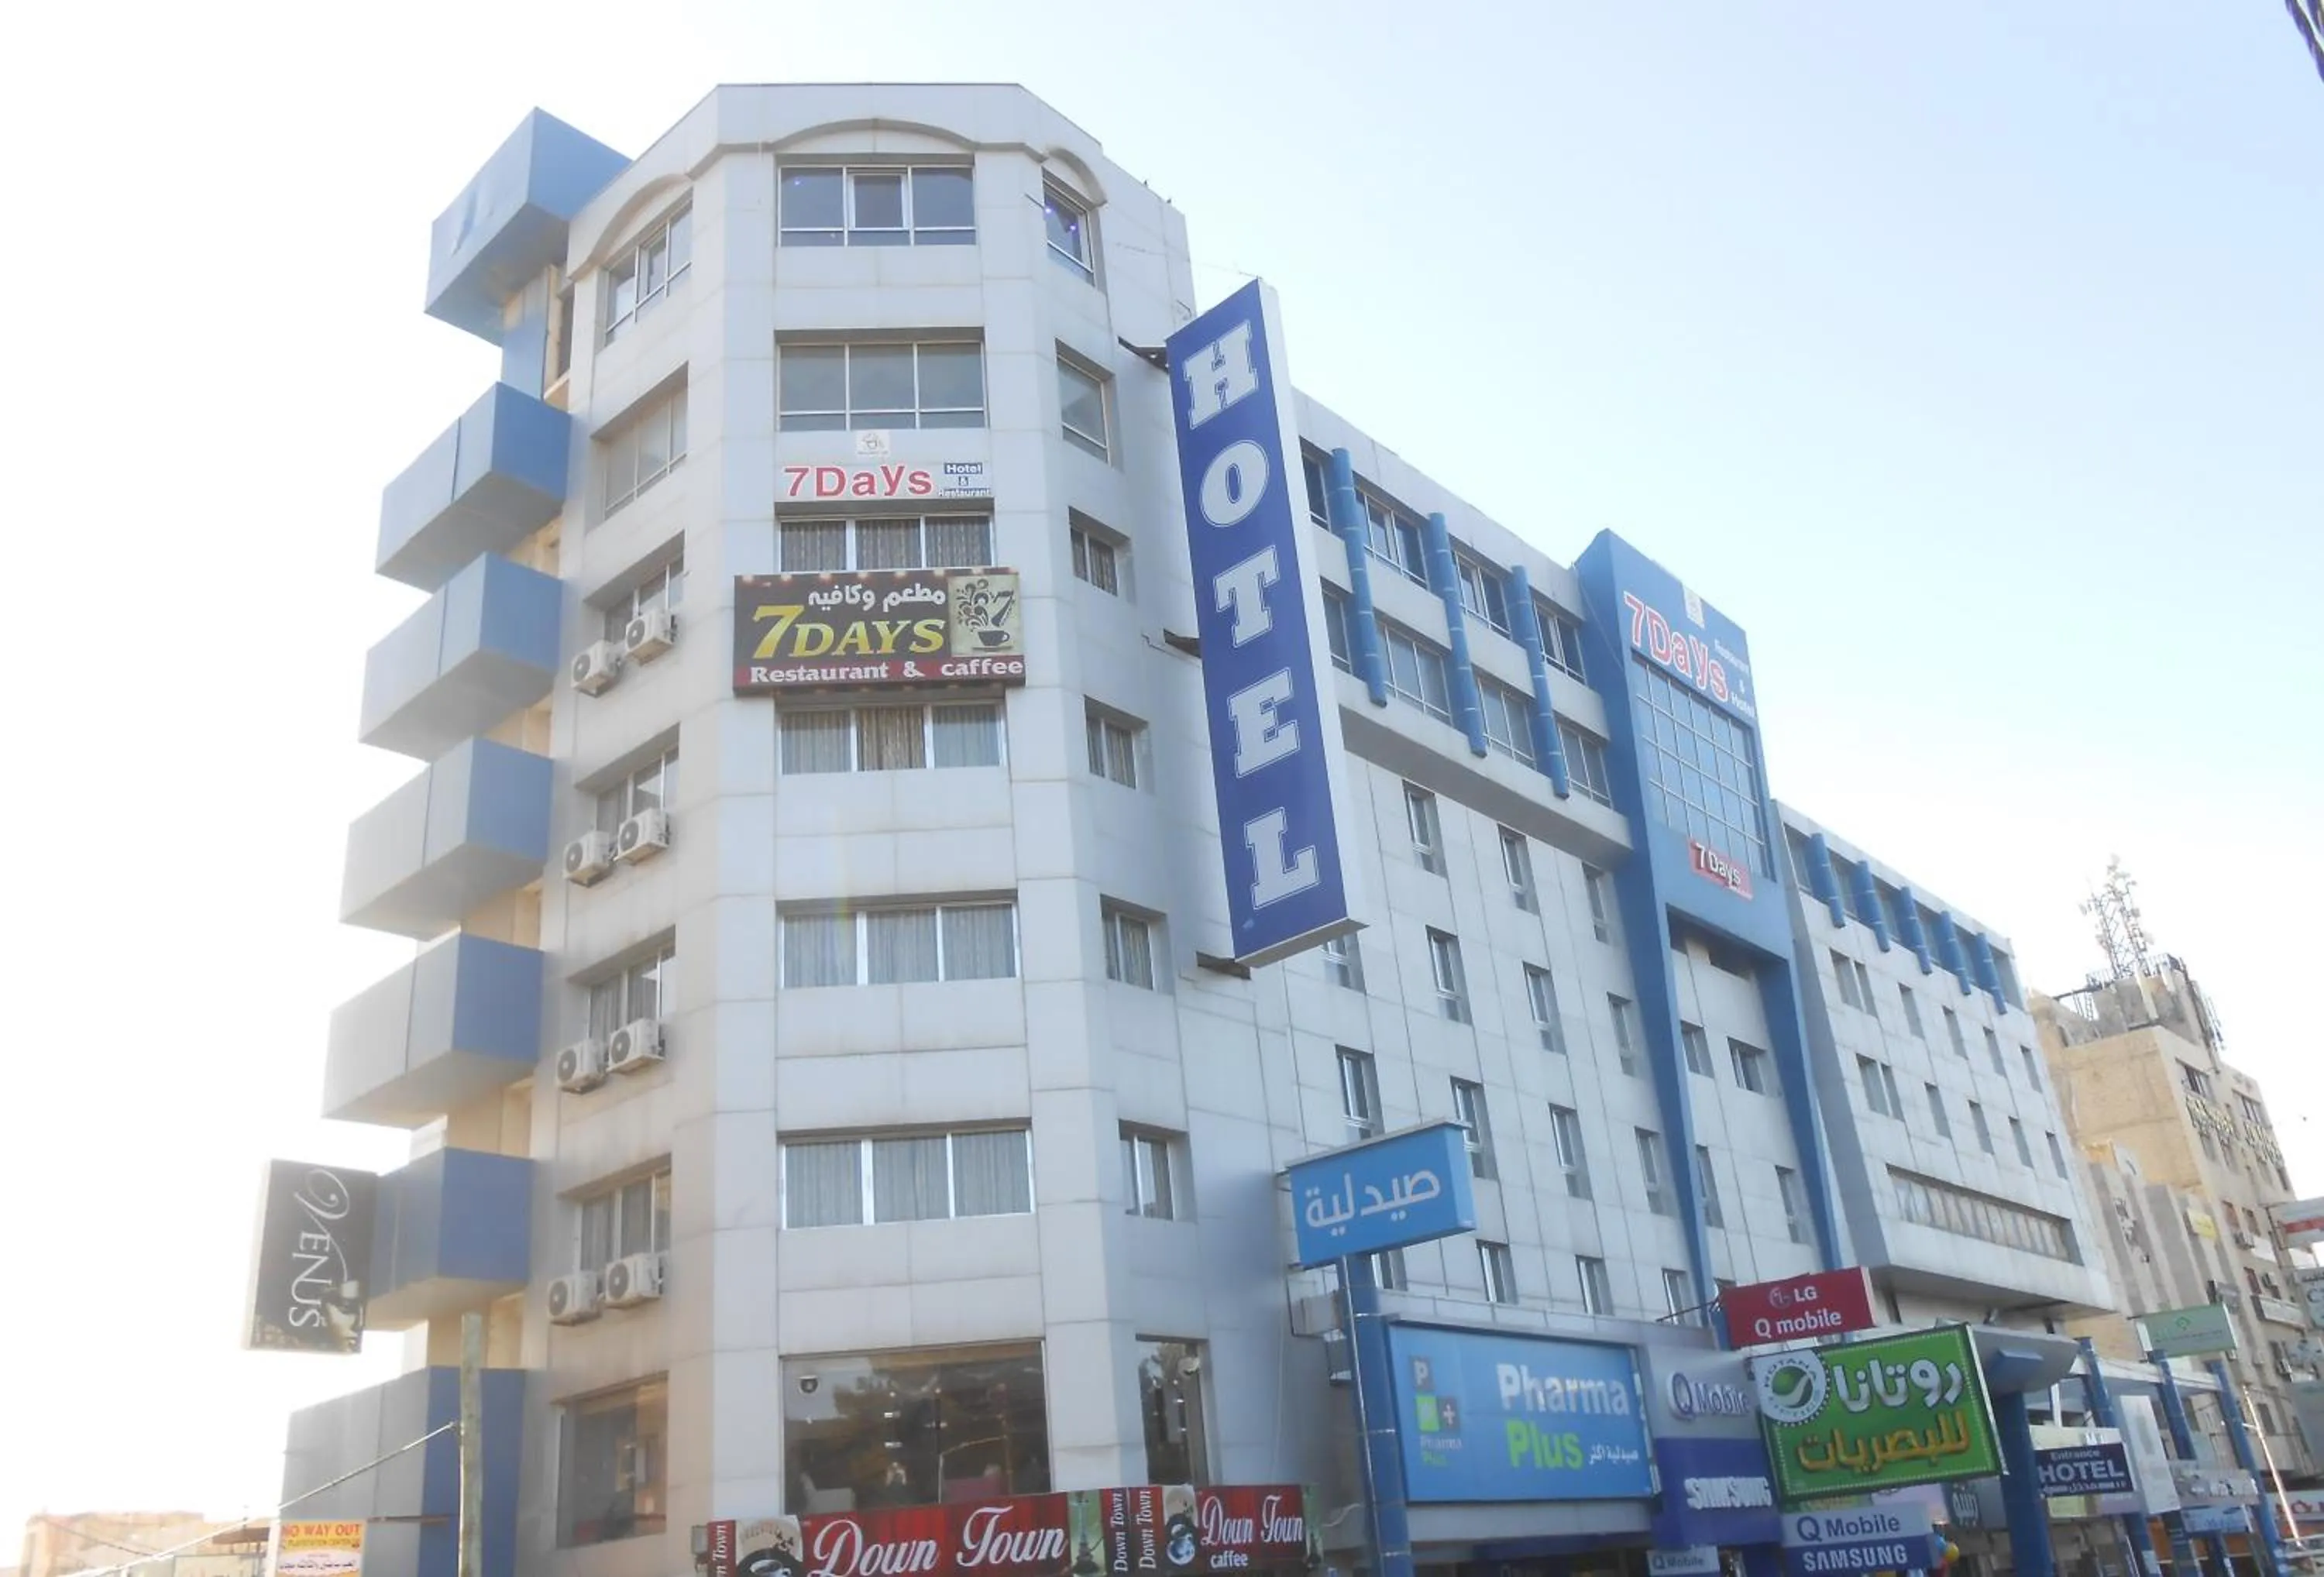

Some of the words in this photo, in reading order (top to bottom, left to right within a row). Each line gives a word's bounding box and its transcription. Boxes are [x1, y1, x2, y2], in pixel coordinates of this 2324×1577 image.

[946, 463, 982, 474] Hotel
[882, 582, 947, 612] مطعم
[1183, 321, 1321, 911] HOTEL
[750, 663, 889, 684] Restaurant
[902, 661, 925, 679] &
[941, 658, 1024, 677] caffee
[1305, 1169, 1441, 1236] صيدلية
[1794, 1286, 1817, 1302] LG
[1496, 1362, 1631, 1416] Pharma
[1832, 1357, 1964, 1414] روتانا
[1504, 1417, 1584, 1469] Plus
[1796, 1409, 1971, 1472] للبصريات
[2037, 1459, 2124, 1483] HOTEL
[1136, 1488, 1151, 1525] Town
[1201, 1496, 1254, 1546] Down
[1260, 1494, 1304, 1544] Town
[807, 1518, 938, 1577] Down
[955, 1505, 1066, 1568] Town
[1113, 1531, 1129, 1572] Down
[1139, 1529, 1157, 1571] Down
[1210, 1549, 1249, 1569] caffee
[1802, 1544, 1908, 1572] SAMSUNG
